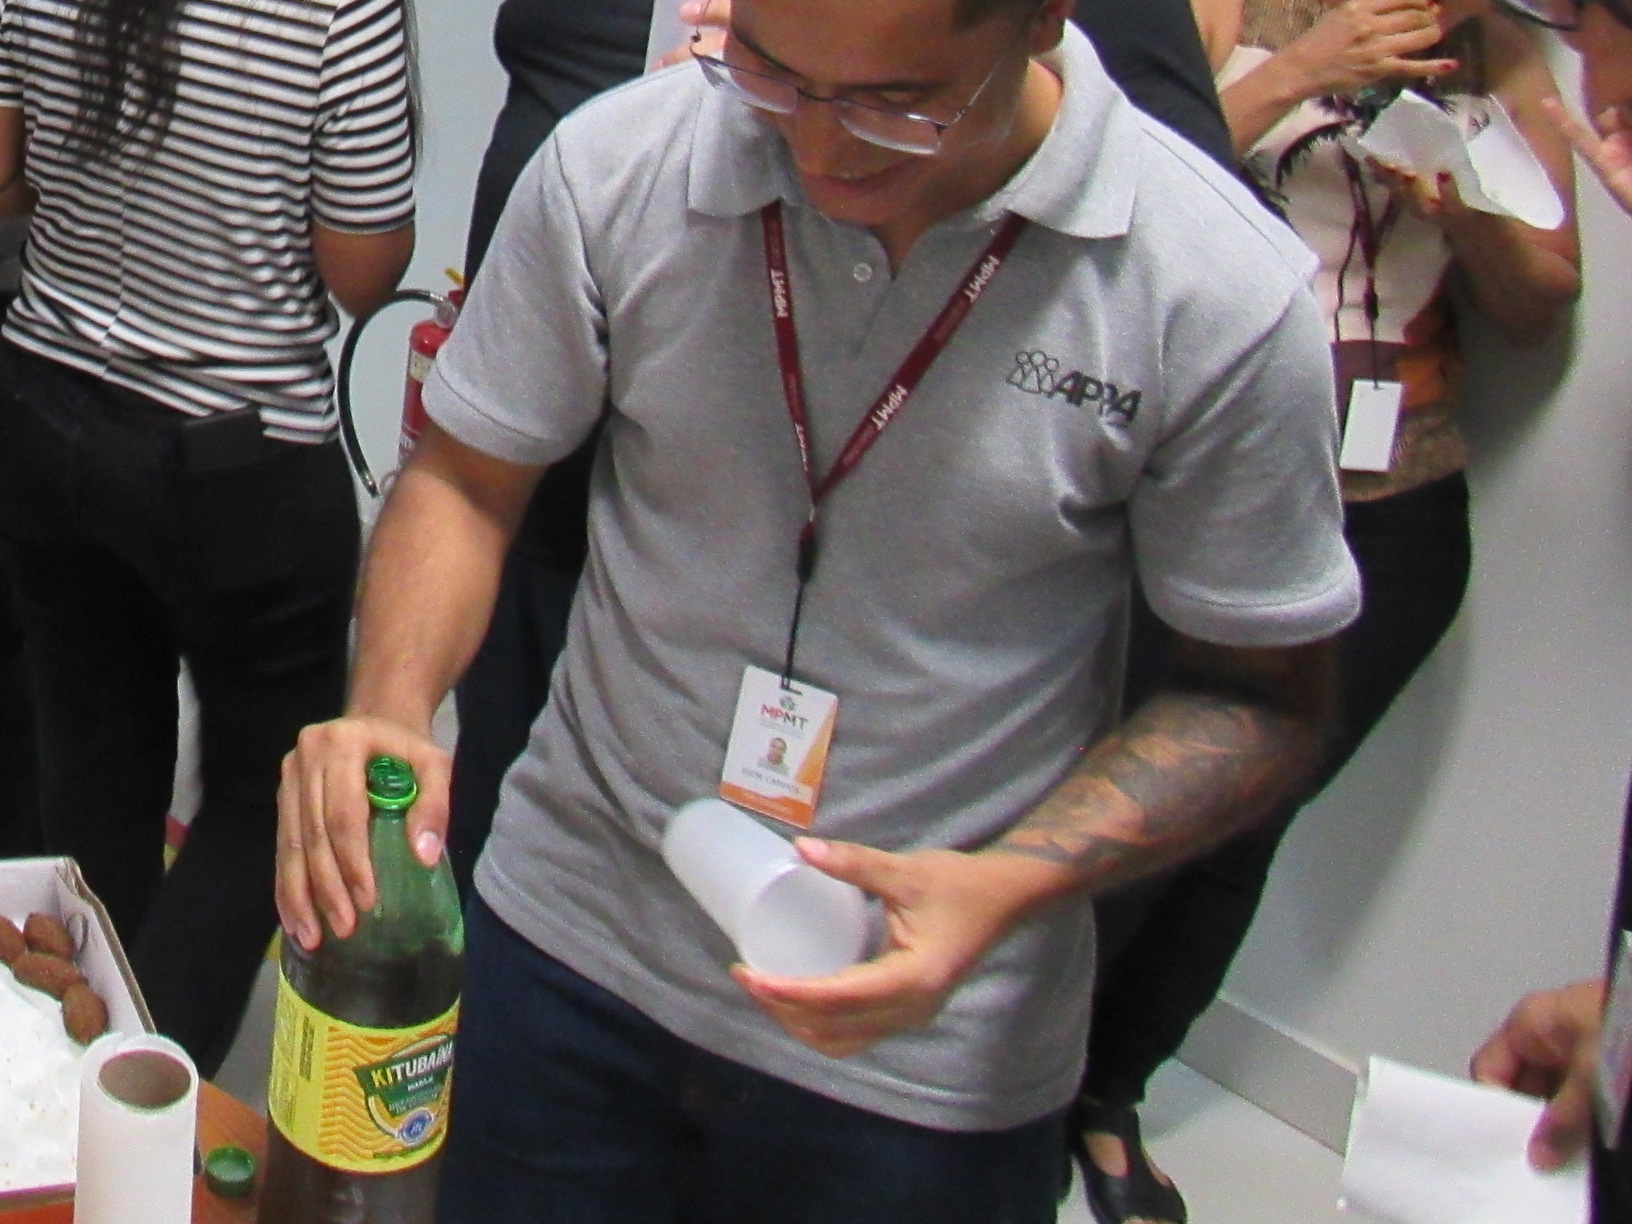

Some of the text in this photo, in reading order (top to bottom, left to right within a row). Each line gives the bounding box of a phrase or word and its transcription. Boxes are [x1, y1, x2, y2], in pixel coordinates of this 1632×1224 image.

[963, 255, 1000, 303] MPMT
[871, 384, 910, 431] MPMT
[761, 703, 809, 730] MPMT
